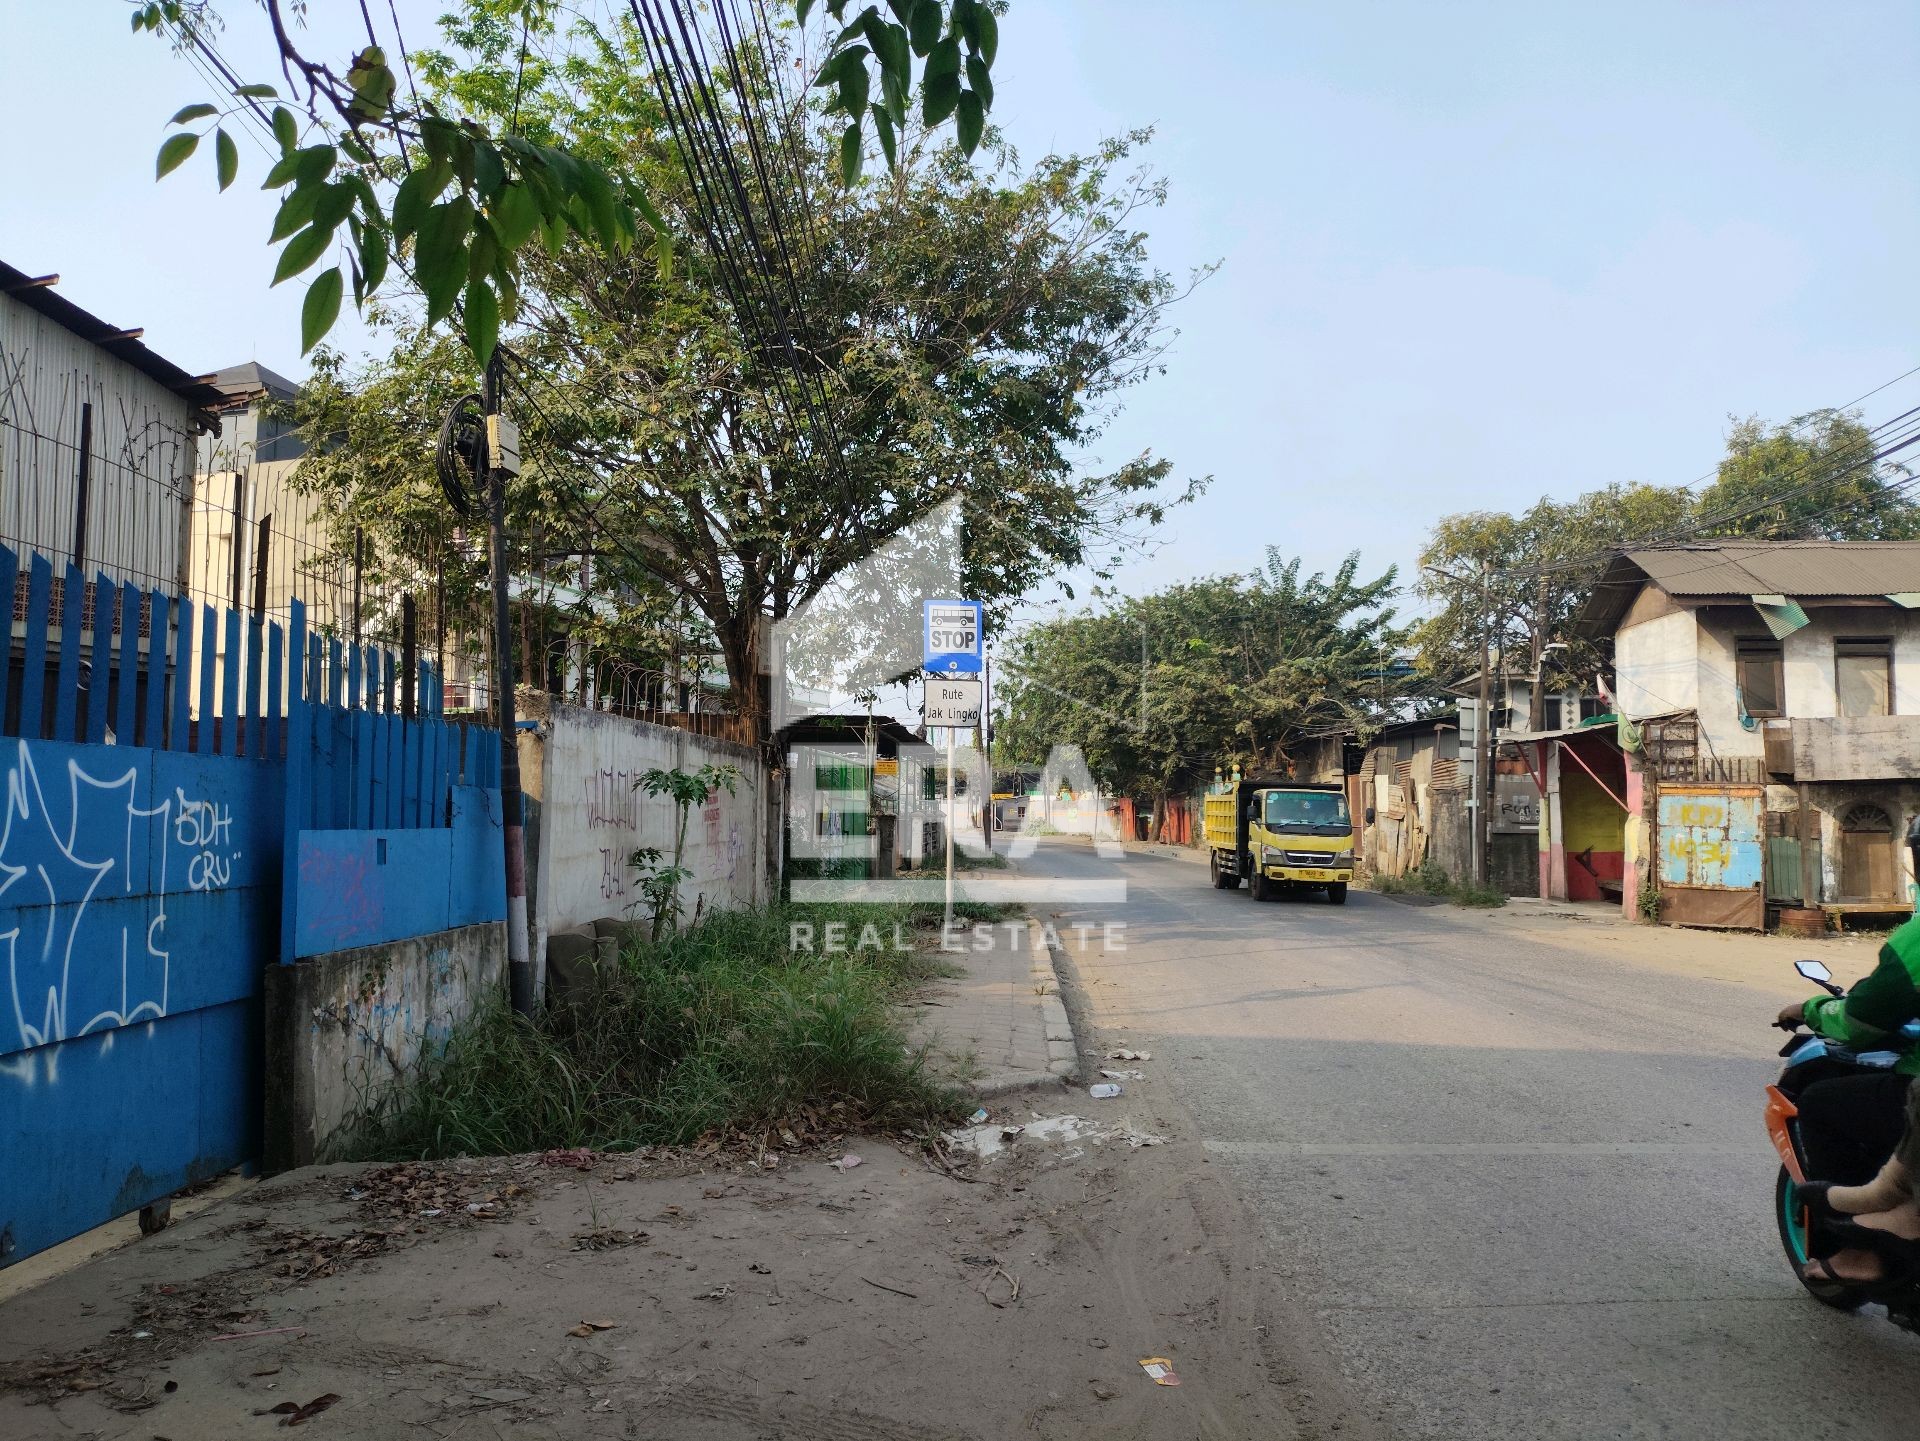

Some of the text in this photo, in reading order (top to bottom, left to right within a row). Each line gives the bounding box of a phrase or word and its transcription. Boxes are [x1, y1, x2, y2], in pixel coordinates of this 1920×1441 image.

[931, 630, 975, 649] STOP
[942, 688, 964, 700] Rute
[927, 707, 978, 723] Jak Lingko
